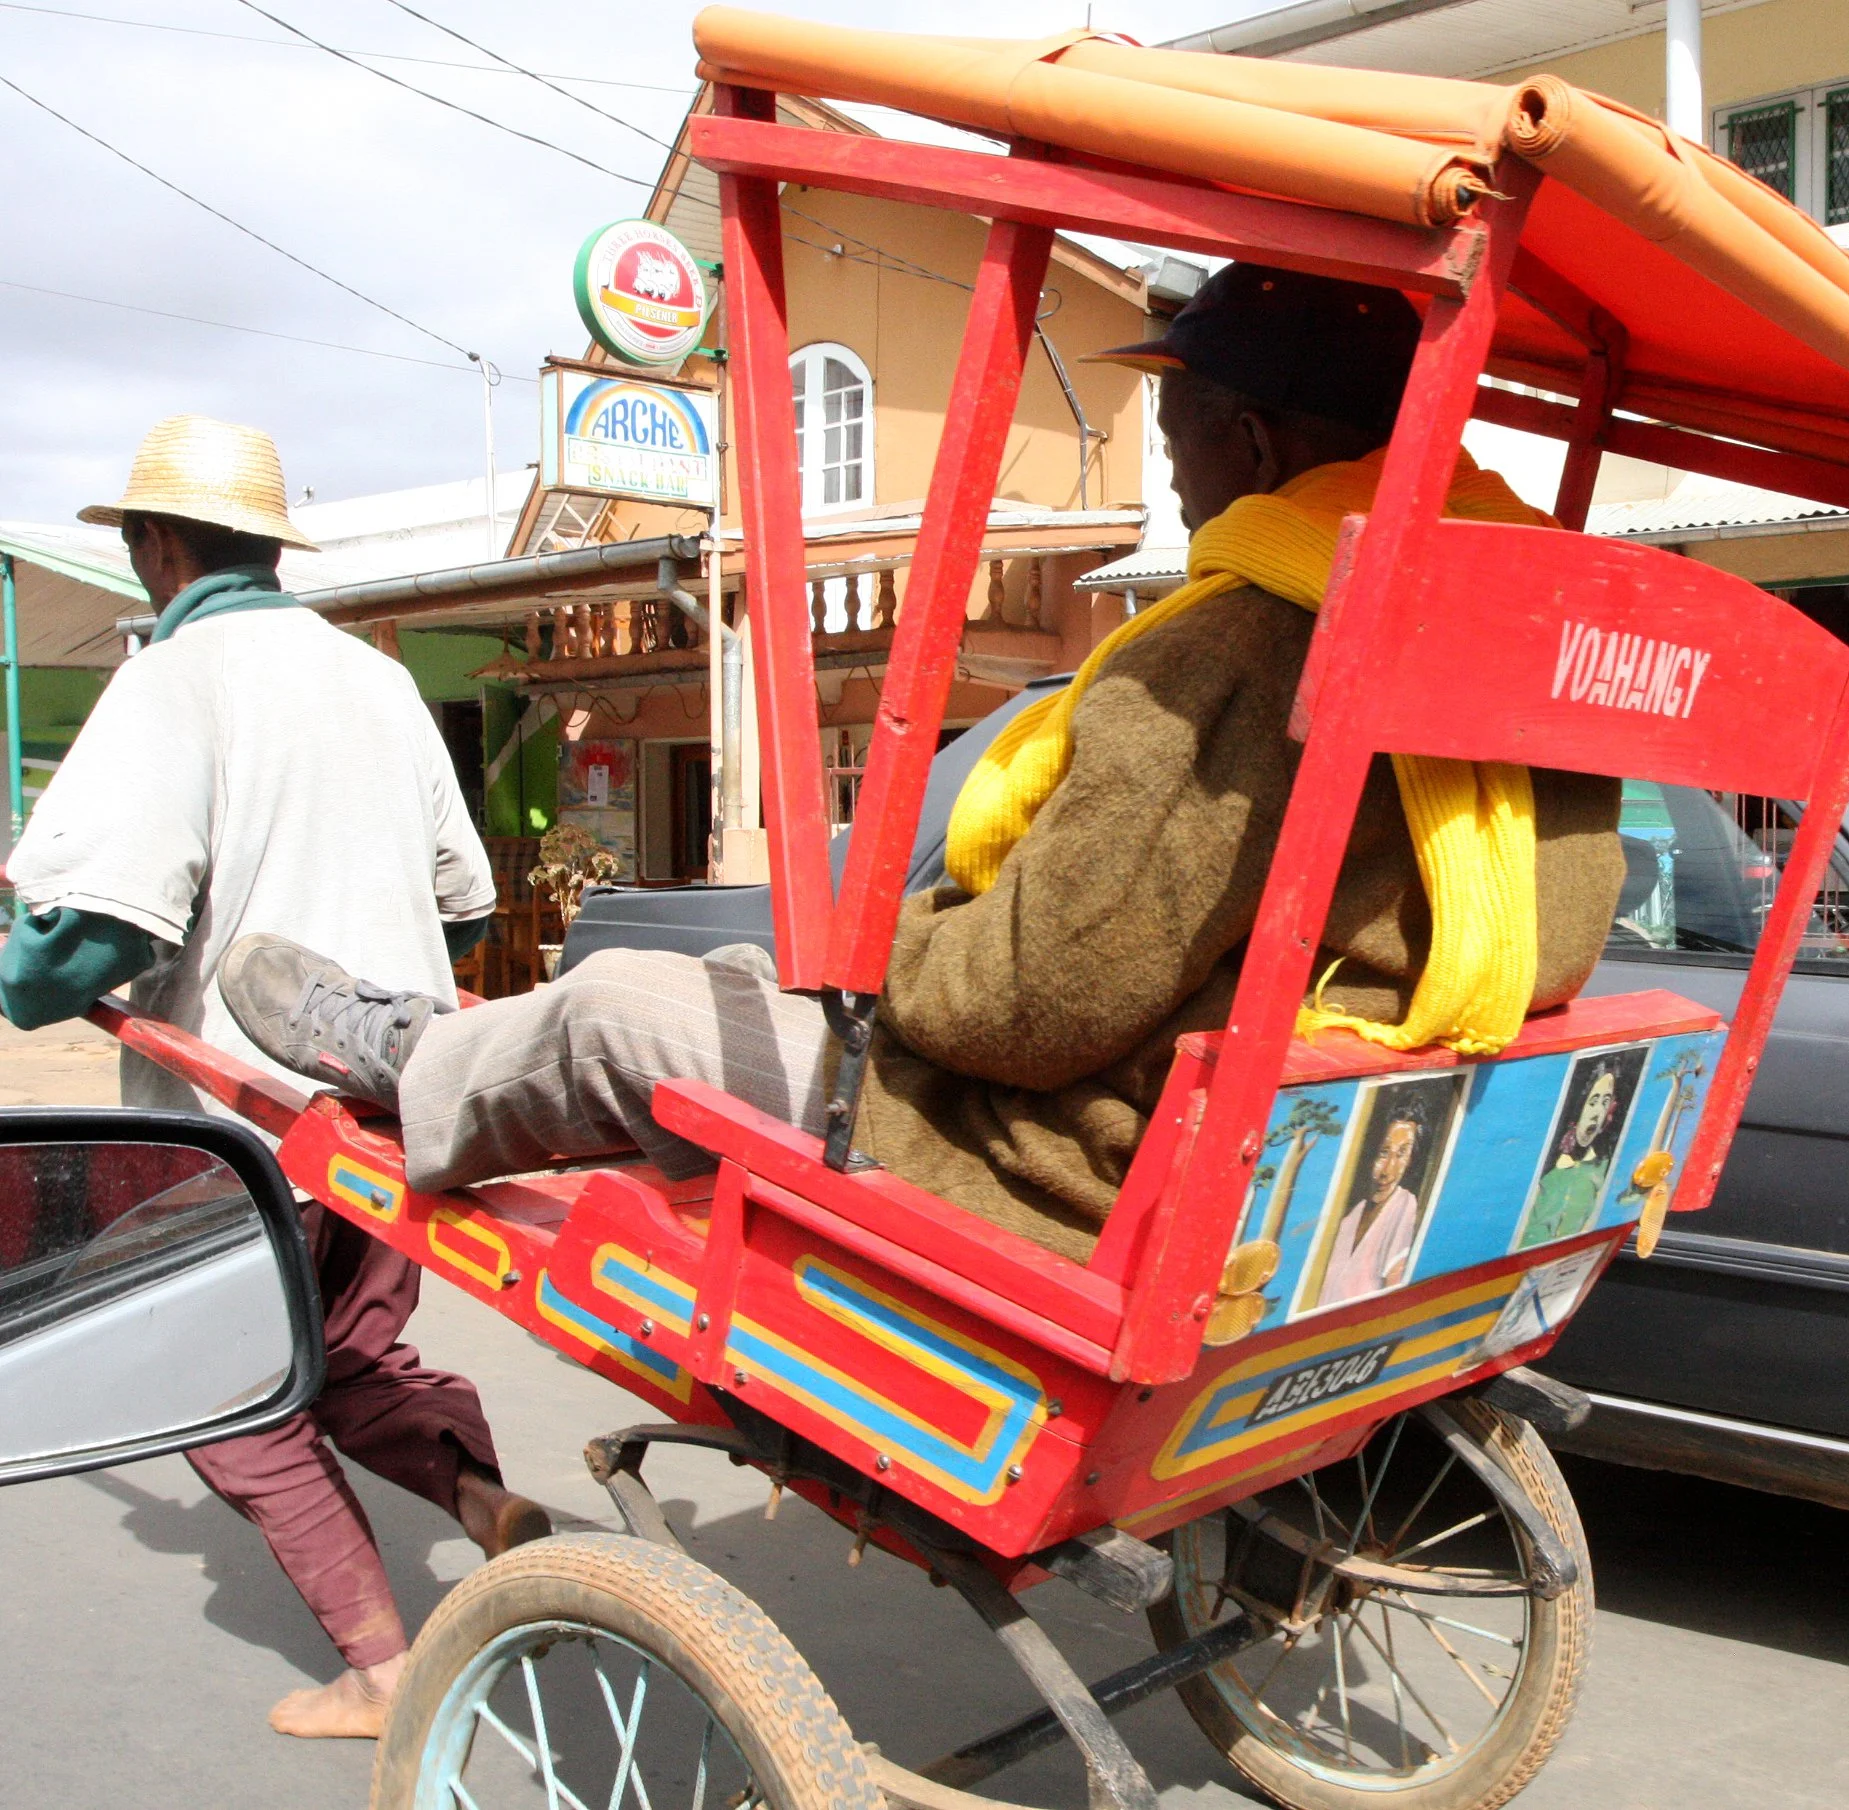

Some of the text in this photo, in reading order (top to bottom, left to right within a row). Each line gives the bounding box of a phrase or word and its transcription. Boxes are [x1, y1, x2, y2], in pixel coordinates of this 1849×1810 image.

[603, 232, 633, 263] THREE
[635, 303, 678, 323] PILSENER
[592, 398, 684, 450] ARCHE
[592, 464, 688, 493] SNACK BAR
[1551, 619, 1712, 719] VOAHANGY
